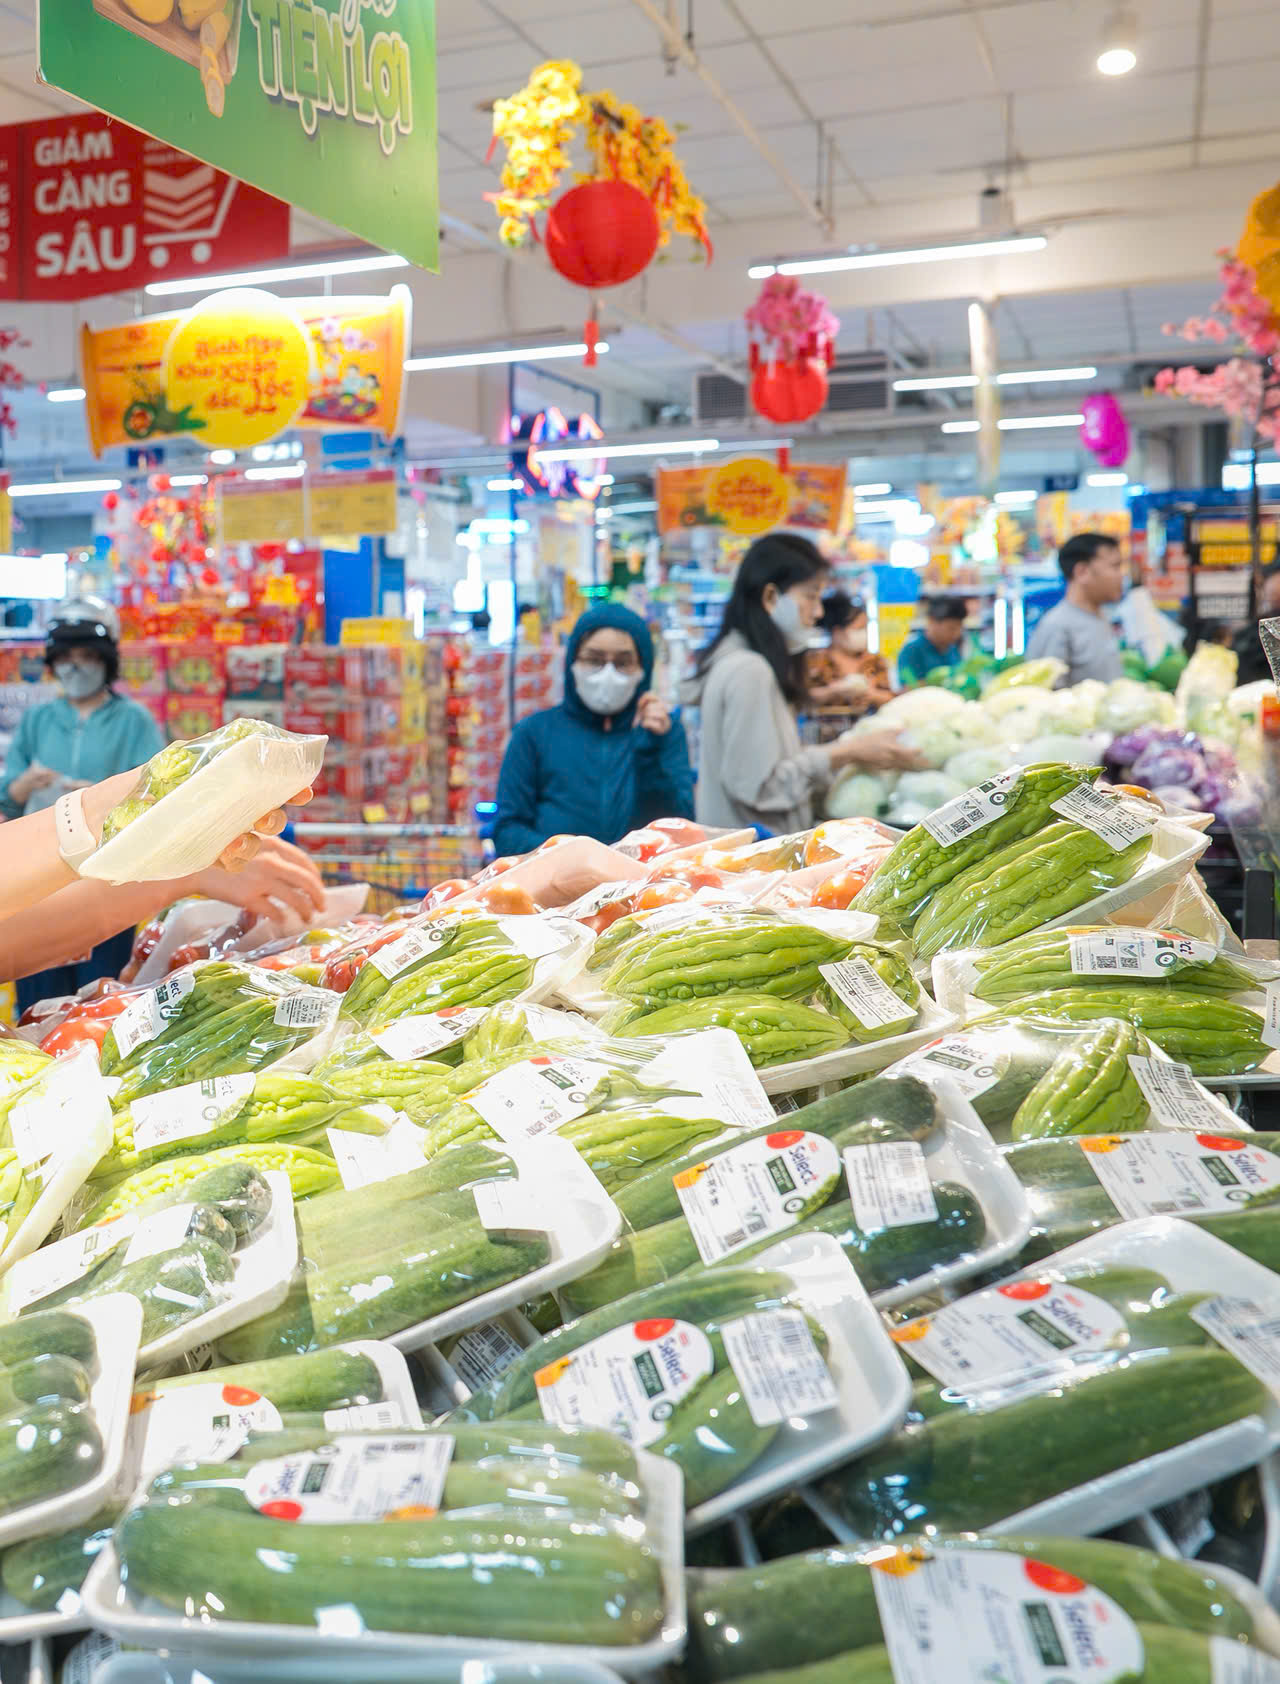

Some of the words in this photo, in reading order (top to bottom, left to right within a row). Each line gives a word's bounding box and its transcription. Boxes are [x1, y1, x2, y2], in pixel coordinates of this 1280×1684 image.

[33, 126, 114, 168] GIẢM
[34, 168, 131, 214] CÀNG
[35, 218, 136, 278] SÂU
[789, 1144, 819, 1186] Select
[1228, 1151, 1268, 1185] Select
[1040, 1297, 1102, 1341] Select
[656, 1336, 690, 1387] Select
[1061, 1600, 1109, 1671] Select
